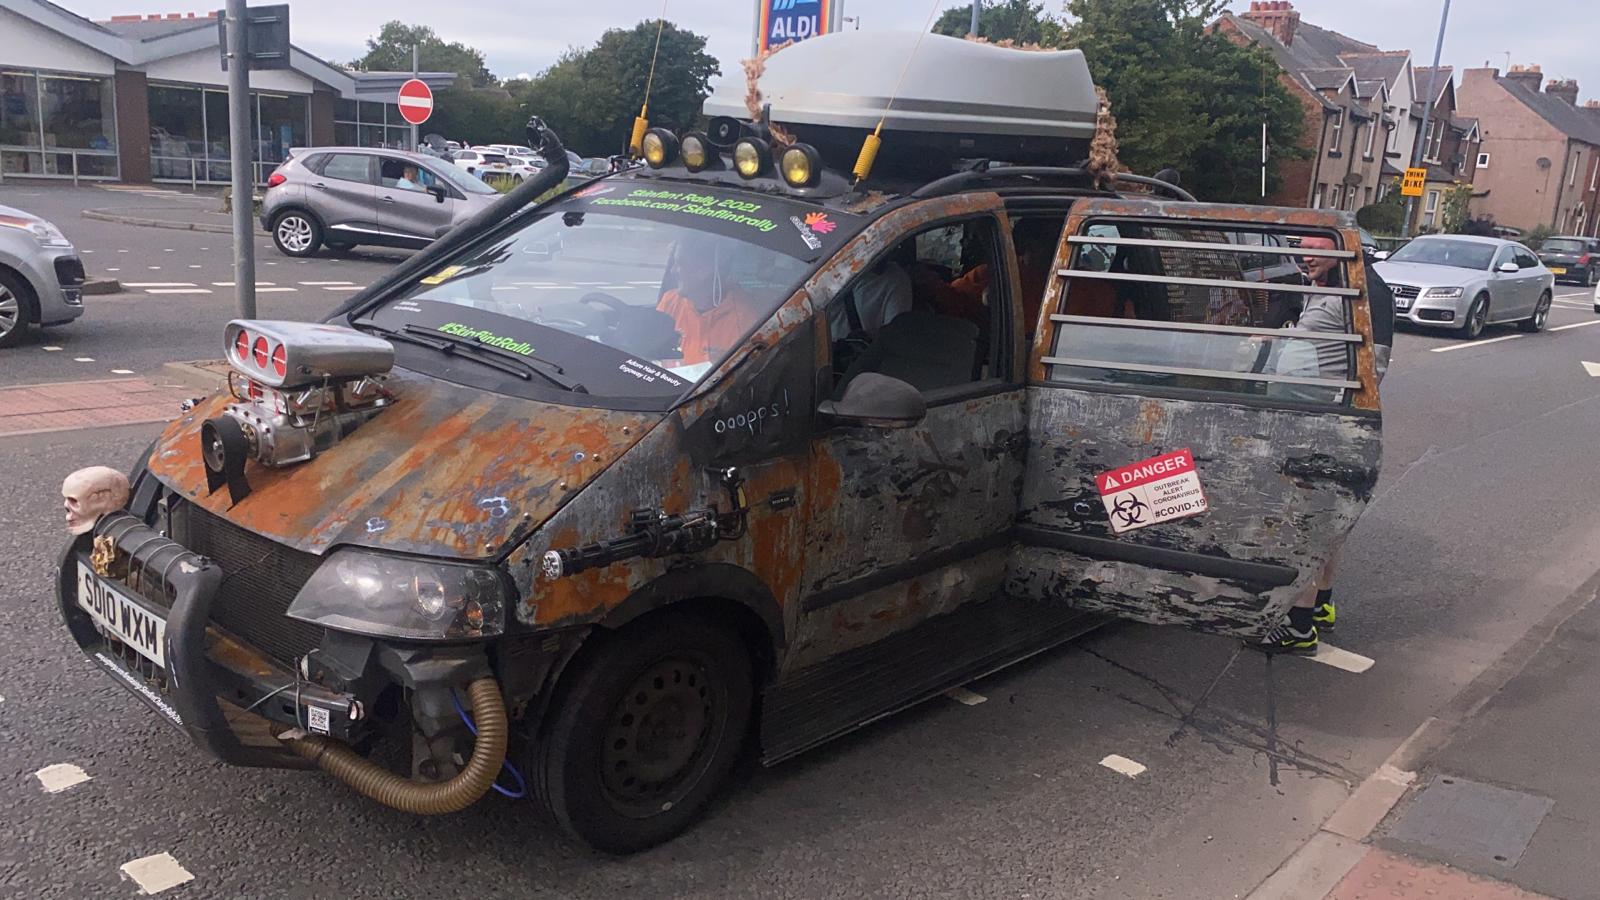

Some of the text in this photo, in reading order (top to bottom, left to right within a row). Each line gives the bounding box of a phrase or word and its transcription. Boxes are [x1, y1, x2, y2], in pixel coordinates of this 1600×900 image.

[771, 15, 817, 38] ALDI
[1404, 179, 1423, 188] BIKE
[1406, 170, 1424, 178] THINK
[680, 193, 719, 207] Rally
[717, 199, 762, 213] 2021
[626, 359, 644, 369] Adore
[643, 365, 656, 374] Hair
[660, 373, 681, 387] Beauty
[643, 374, 655, 382] Ltd
[1120, 456, 1188, 483] DANGER
[1153, 477, 1190, 492] OUTBREAK
[1162, 485, 1184, 496] ALERT
[1153, 488, 1200, 506] CORONAVIRUS
[1154, 498, 1206, 518] #COVID-19
[120, 600, 158, 655] WXM
